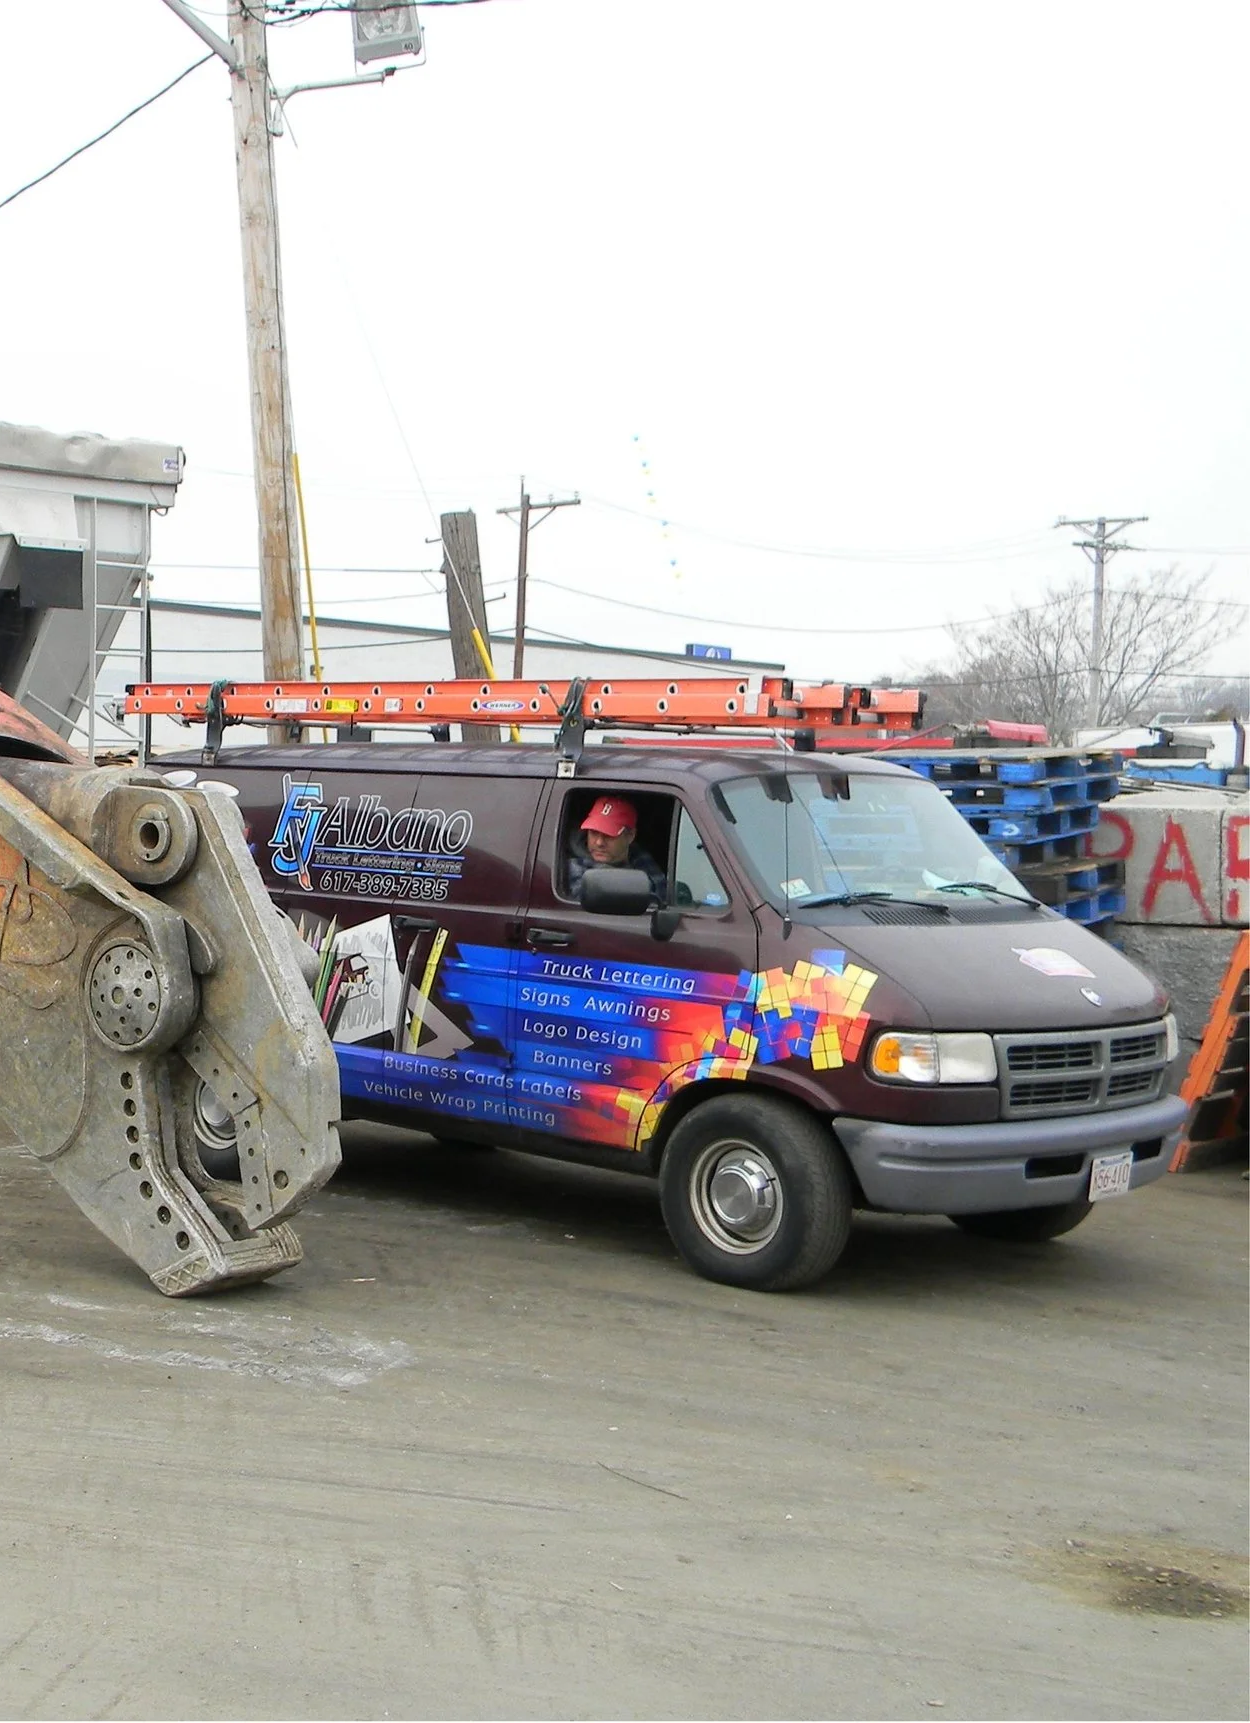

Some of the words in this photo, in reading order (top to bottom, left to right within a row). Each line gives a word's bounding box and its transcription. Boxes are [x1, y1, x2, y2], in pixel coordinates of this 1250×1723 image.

[601, 803, 613, 816] B
[268, 781, 327, 876] FJ
[316, 793, 473, 855] Albano
[314, 851, 350, 865] Truck
[352, 853, 415, 874] Lettering
[423, 858, 462, 875] Signs
[320, 870, 449, 899] 617-389-7335
[543, 960, 594, 979] Truck
[600, 967, 696, 994] Lettering
[521, 987, 571, 1007] Signs
[584, 996, 671, 1022] Awnings
[523, 1018, 568, 1038] Logo
[576, 1025, 642, 1050] Design
[383, 1056, 458, 1080] Business
[464, 1069, 514, 1089] Cards
[521, 1079, 582, 1101] Labels
[533, 1050, 613, 1075] Banners
[363, 1079, 423, 1102] Vehicle
[430, 1090, 476, 1112] Wrap
[483, 1100, 556, 1127] Printing
